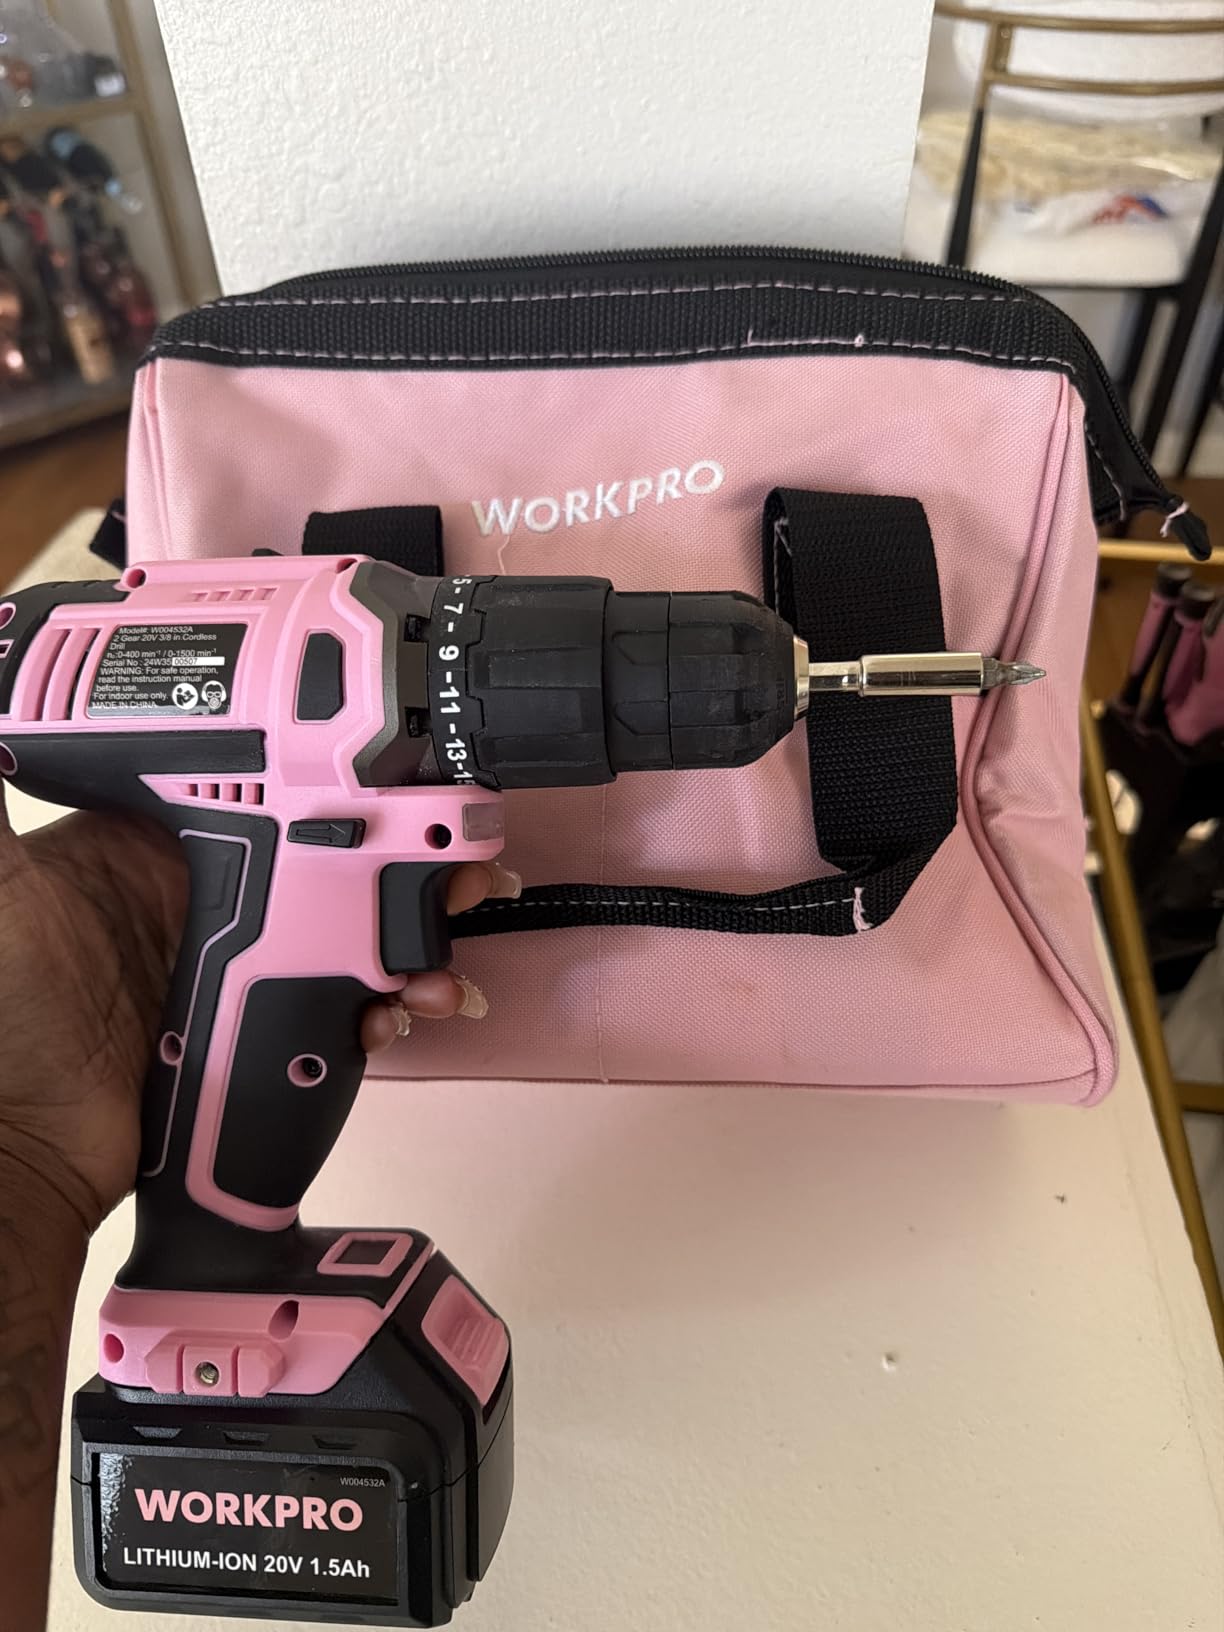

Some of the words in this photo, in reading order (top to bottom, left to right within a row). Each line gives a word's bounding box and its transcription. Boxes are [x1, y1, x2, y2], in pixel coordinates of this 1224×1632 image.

[471, 459, 725, 536] WORKPRO
[443, 602, 464, 615] 7
[141, 634, 159, 642] 20V
[168, 650, 195, 658] 0-1500
[438, 645, 460, 661] 9
[103, 659, 125, 667] Serial
[100, 667, 144, 675] WARNING:
[161, 666, 178, 674] safe
[179, 666, 218, 675] operation,
[132, 675, 171, 683] instruction
[150, 692, 168, 701] only.
[439, 686, 461, 714] 11
[445, 738, 468, 762] 13
[340, 1477, 386, 1488] W004532A
[134, 1488, 363, 1532] WORKPRO
[123, 1547, 257, 1572] LITHIUM-ION
[263, 1555, 303, 1575] 20V
[310, 1557, 370, 1578] 1.5Ah
